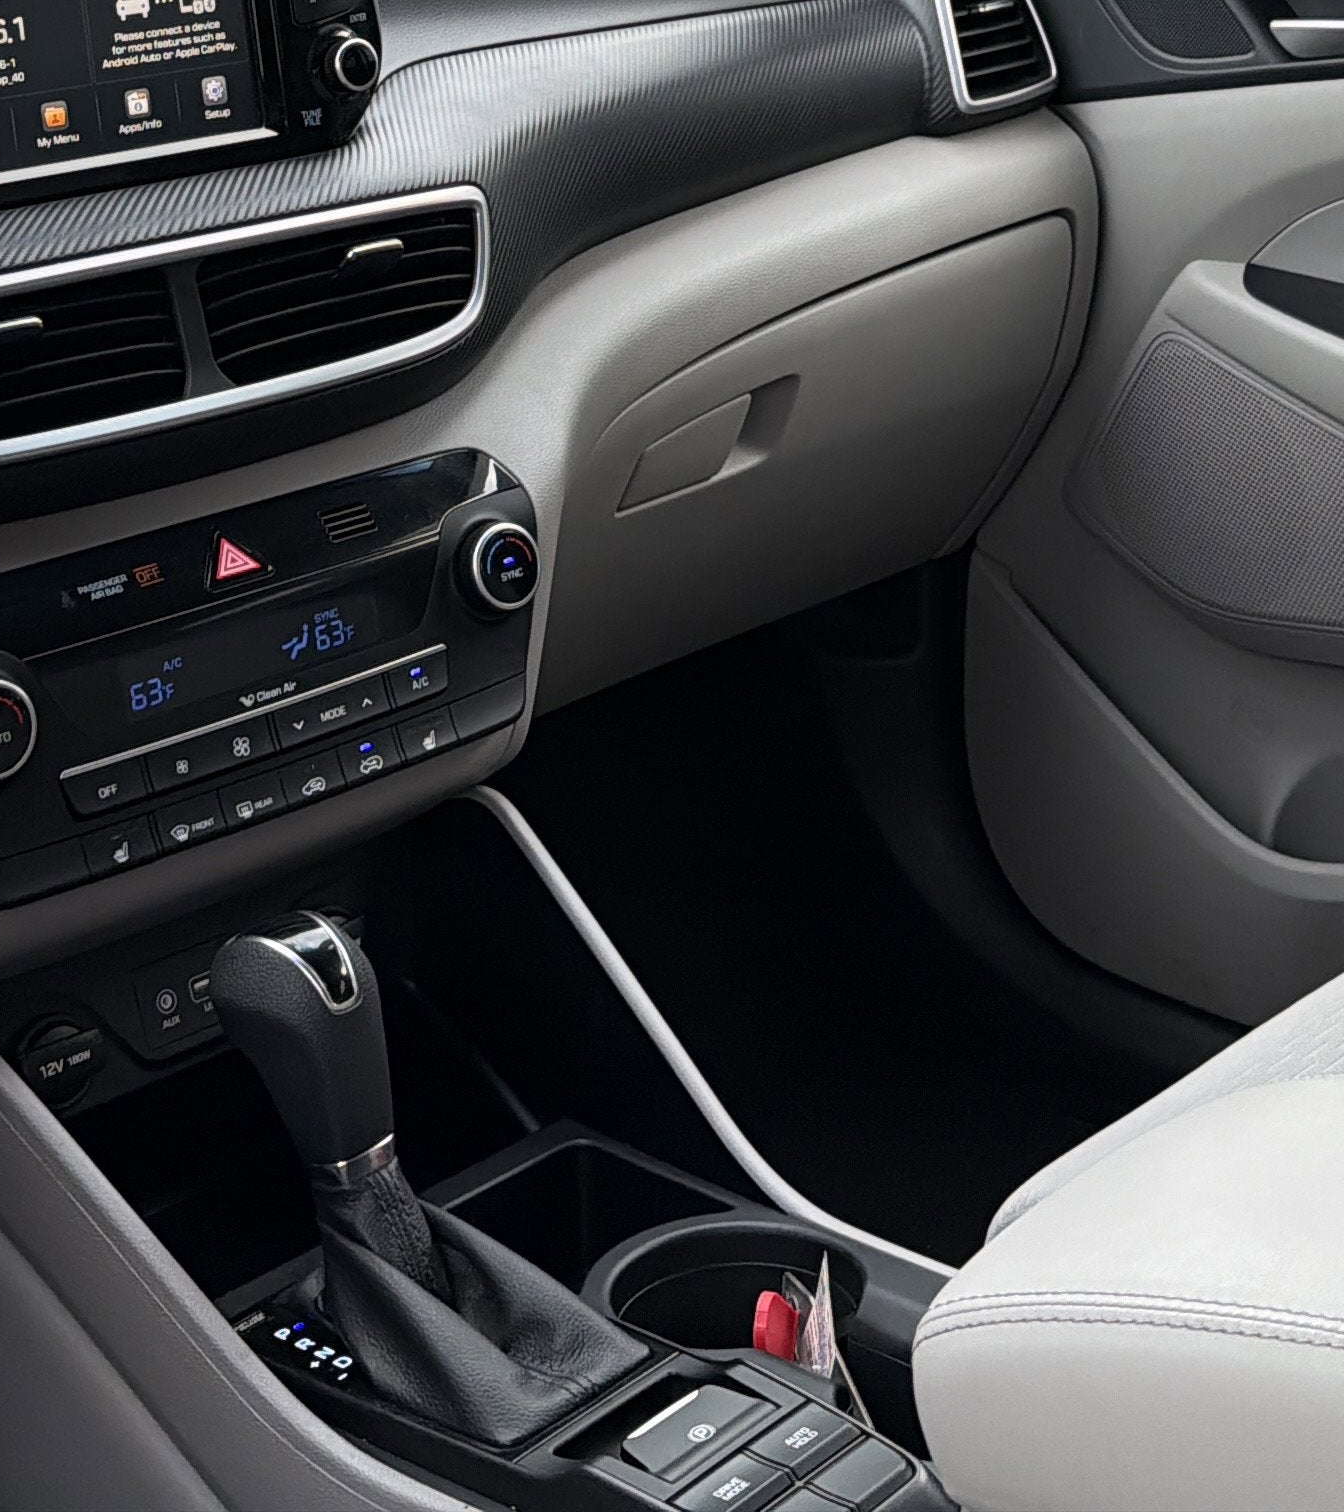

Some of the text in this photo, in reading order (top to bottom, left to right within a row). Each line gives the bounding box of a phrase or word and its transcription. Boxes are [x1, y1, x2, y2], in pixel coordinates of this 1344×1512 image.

[114, 31, 145, 42] Please
[146, 25, 183, 38] connect
[191, 20, 221, 32] device
[111, 31, 227, 55] for more features such as
[102, 41, 238, 69] Android Auto or Apple CarPlay.
[204, 108, 232, 120] Setup
[301, 107, 323, 120] TUNE
[119, 118, 163, 136] Apps/Info
[304, 116, 322, 128] FILE
[36, 132, 80, 149] My Menu
[77, 566, 161, 595] PASSENGER OFF
[500, 567, 524, 582] SYNC
[90, 584, 124, 601] AIR BAG
[314, 607, 339, 623] SYNC
[162, 656, 183, 672] A/C
[412, 675, 429, 691] A/C
[256, 681, 298, 703] Clean Air
[319, 704, 348, 723] MODE
[97, 783, 118, 799] OFF
[255, 796, 274, 810] REAR
[190, 816, 216, 832] FRONT
[162, 1014, 181, 1030] AUX
[39, 1048, 92, 1079] 12V 180W
[273, 1327, 291, 1341] P
[294, 1337, 316, 1351] R
[332, 1356, 353, 1369] D
[784, 1426, 810, 1447] AUTO
[790, 1429, 819, 1449] HOLD
[711, 1476, 743, 1498] DRIVE
[720, 1479, 752, 1502] MODE
